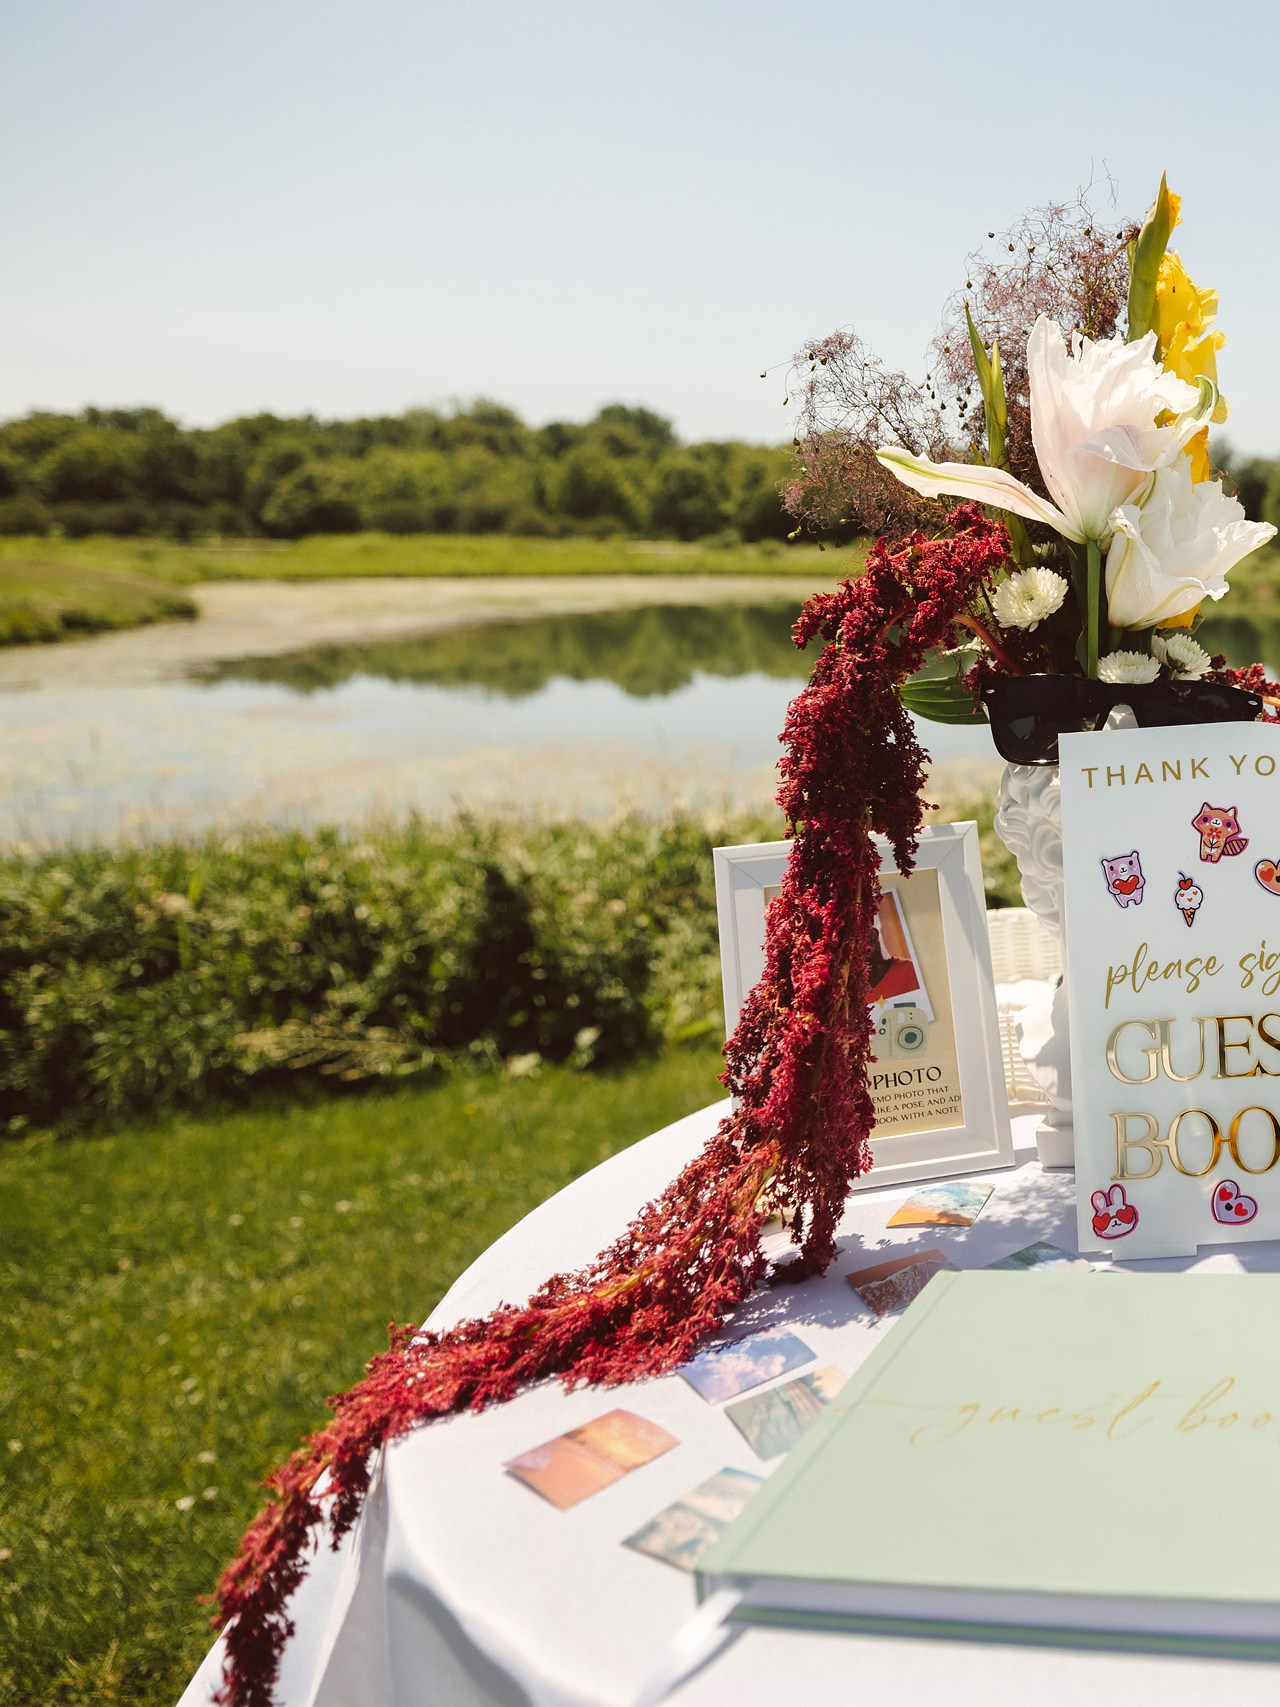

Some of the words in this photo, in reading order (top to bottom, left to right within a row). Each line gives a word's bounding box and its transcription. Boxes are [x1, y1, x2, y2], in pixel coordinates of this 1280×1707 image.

[1081, 756, 1210, 790] THANK
[1104, 942, 1224, 1009] please
[873, 1066, 941, 1090] PHOTO
[872, 1094, 892, 1104] EMO
[894, 1089, 925, 1101] PHOTO
[926, 1085, 950, 1096] THAT
[874, 1105, 891, 1114] IKE
[927, 1097, 946, 1106] AND
[948, 1095, 962, 1103] AD
[900, 1111, 925, 1121] WITH
[935, 1105, 959, 1115] NOTE
[909, 1379, 1163, 1447] guest
